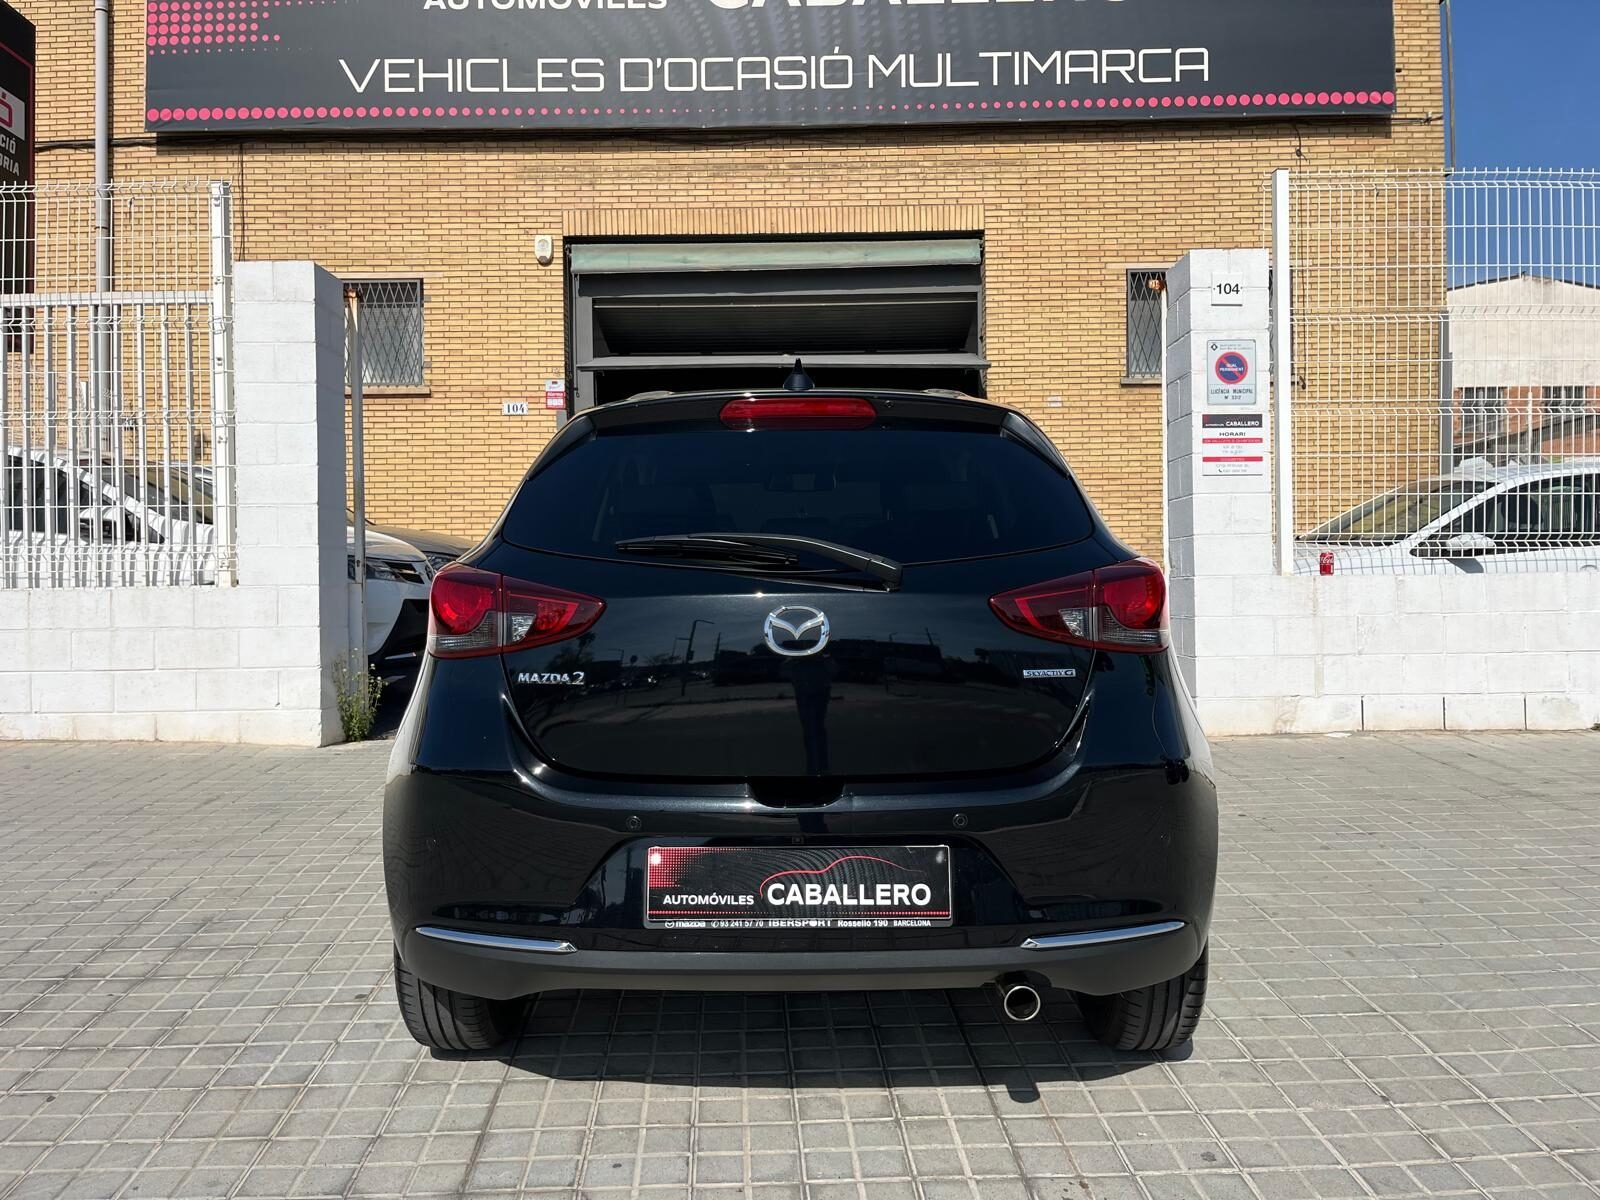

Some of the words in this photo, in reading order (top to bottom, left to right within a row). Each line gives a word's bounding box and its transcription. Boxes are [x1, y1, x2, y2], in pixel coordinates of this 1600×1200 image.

[338, 58, 605, 93] VEHICLES
[619, 46, 853, 92] D'OCASIÓ
[868, 47, 1209, 89] MULTIMARCA
[1216, 283, 1240, 295] 104
[507, 403, 525, 413] 104
[663, 891, 754, 905] AUTOMÓVILES
[767, 883, 931, 906] CABALLERO
[874, 919, 889, 927] 190
[893, 919, 931, 927] BARCELONA
